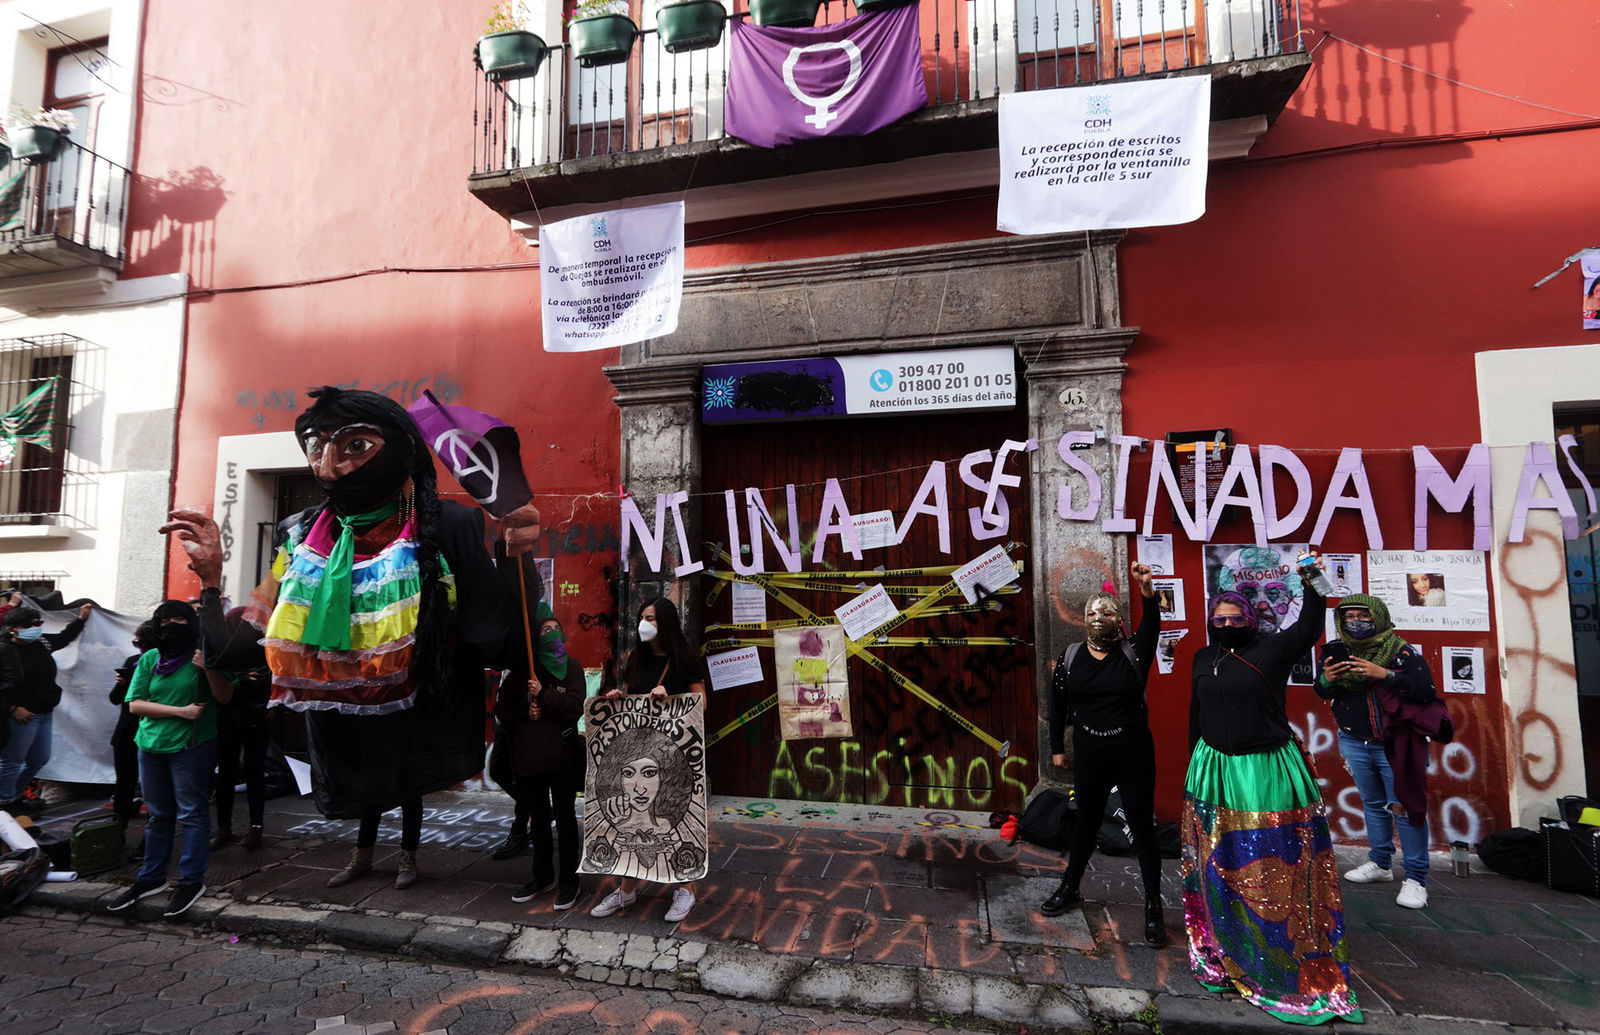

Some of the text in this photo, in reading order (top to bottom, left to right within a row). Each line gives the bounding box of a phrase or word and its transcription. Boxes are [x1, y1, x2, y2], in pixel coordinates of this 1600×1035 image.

[1084, 119, 1112, 130] CDH
[1022, 133, 1181, 156] La recepción de escritos
[1032, 146, 1173, 168] y correspondencia se
[1015, 157, 1191, 179] realizará por la ventanilla
[1048, 171, 1152, 186] en la calle 5 sur
[593, 239, 611, 249] CDH
[548, 246, 677, 275] De manera temporal la recepción
[560, 273, 569, 282] de
[594, 269, 602, 278] se
[605, 263, 646, 276] realizará
[648, 261, 658, 270] en
[660, 256, 667, 266] el
[582, 273, 644, 288] ombudsmóvil.
[548, 298, 558, 306] La
[561, 296, 591, 307] atención
[602, 289, 640, 303] brindará
[577, 307, 586, 316] de
[587, 305, 604, 314] 8:00
[612, 299, 635, 311] 16:00
[571, 311, 611, 324] telefónica
[899, 362, 965, 379] 309 47 00
[899, 373, 1013, 393] 01800 201 01 05
[870, 388, 1016, 409] Atención los 365 días del año.
[220, 460, 238, 563] ESTADO
[853, 516, 892, 527] AUSURADO!
[620, 490, 705, 579] NI
[725, 477, 865, 575] UNA
[1370, 554, 1384, 566] NO
[1232, 563, 1291, 584] MISOGINO
[872, 612, 908, 640] PRECAUCION
[620, 696, 664, 717] TOCAS
[670, 695, 701, 719] UNA
[590, 712, 705, 796] RESPONDEMOS TODAS
[769, 738, 1028, 807] ASESINOS
[775, 857, 892, 912] LA
